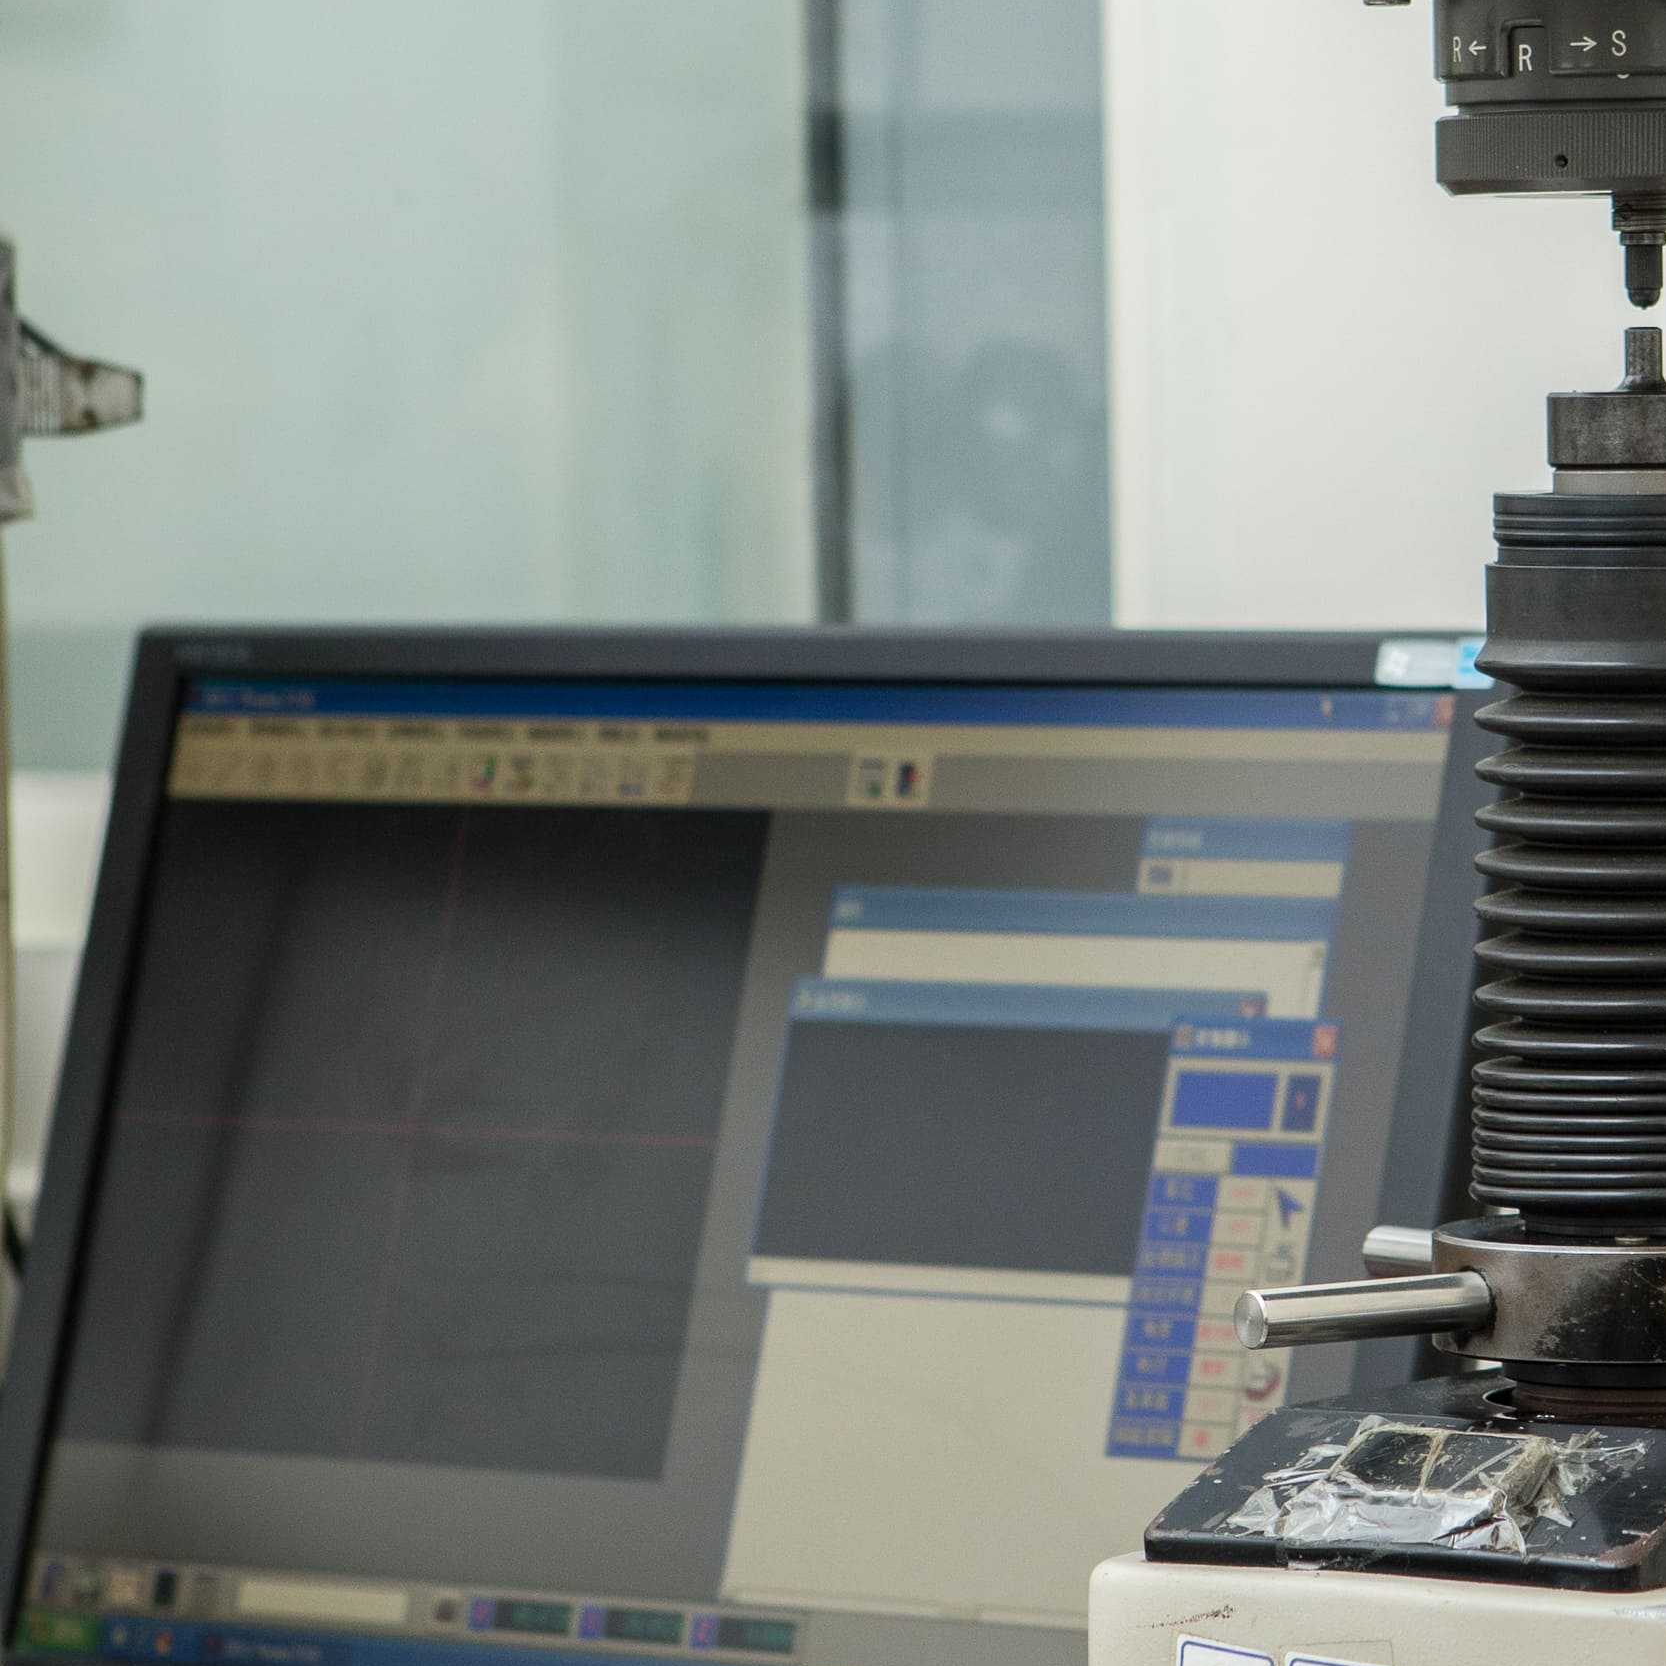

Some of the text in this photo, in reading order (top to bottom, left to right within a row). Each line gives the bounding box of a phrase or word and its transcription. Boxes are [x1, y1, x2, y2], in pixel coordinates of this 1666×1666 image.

[1452, 29, 1627, 63] R S
[1518, 44, 1533, 72] R
